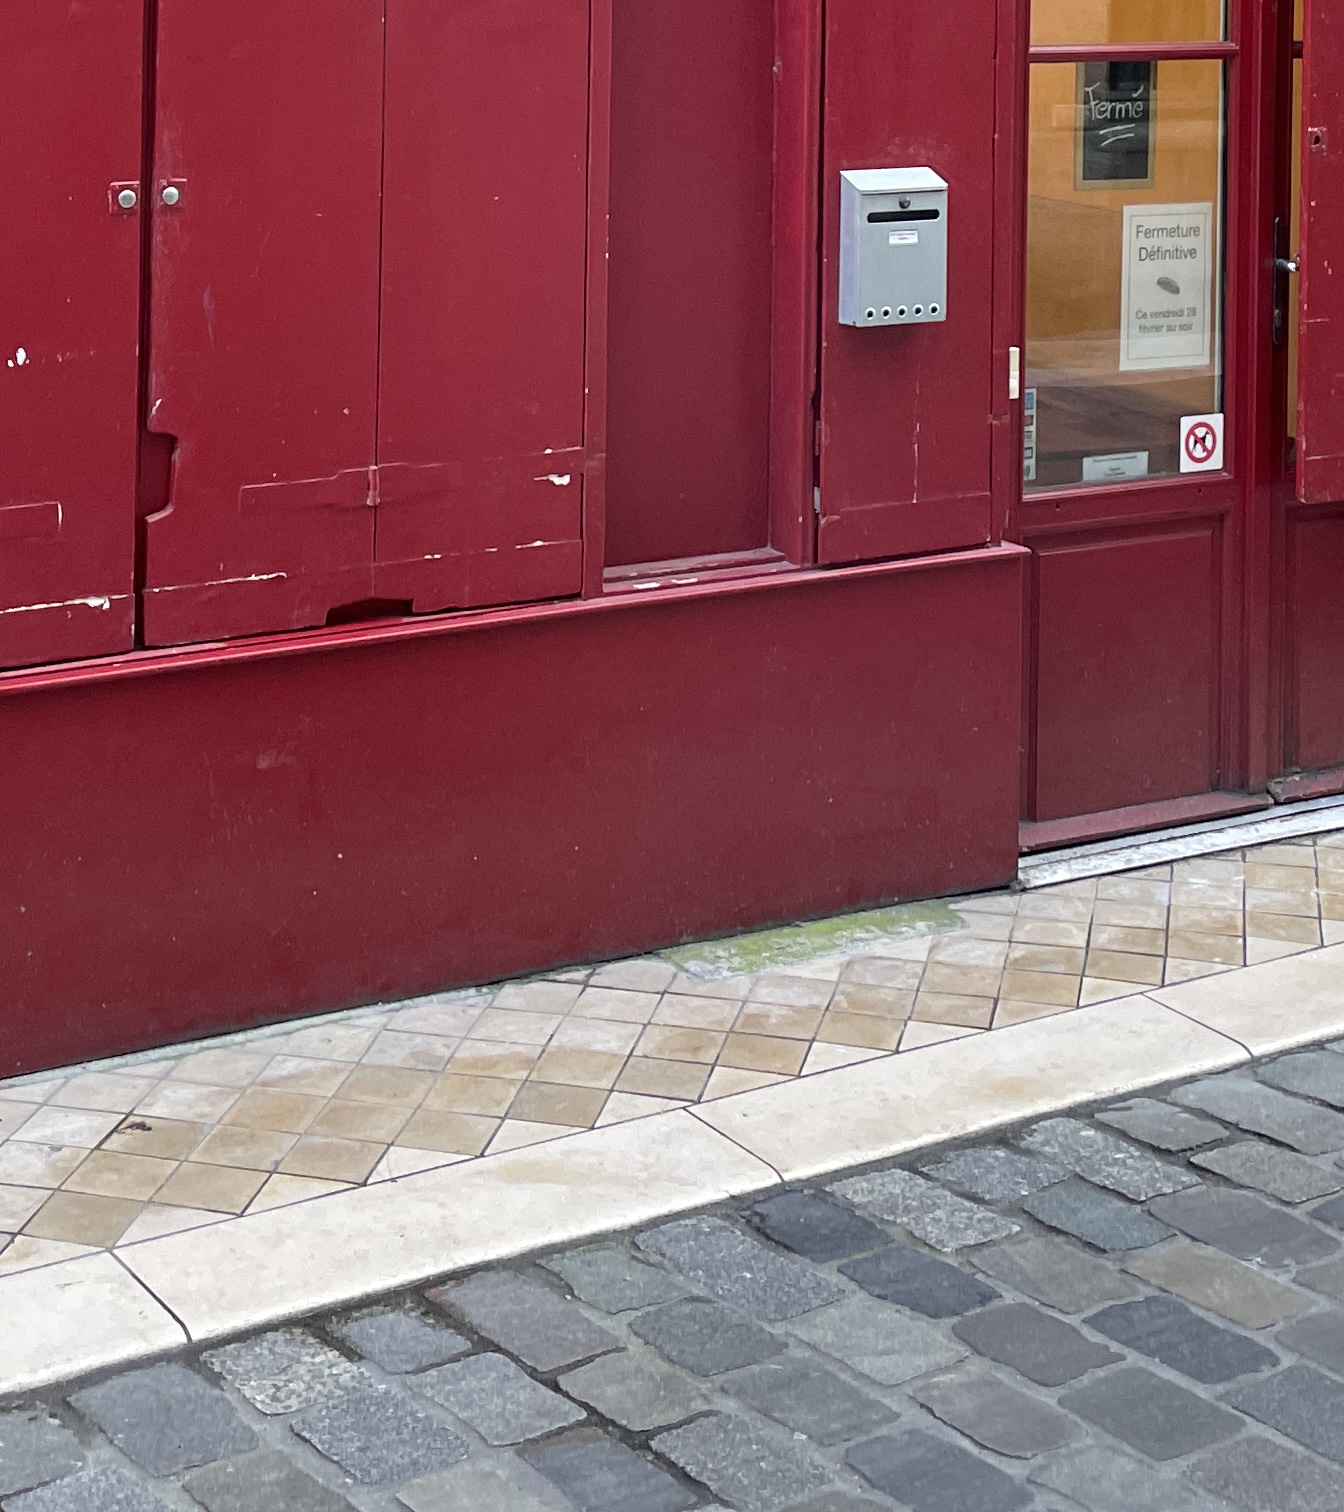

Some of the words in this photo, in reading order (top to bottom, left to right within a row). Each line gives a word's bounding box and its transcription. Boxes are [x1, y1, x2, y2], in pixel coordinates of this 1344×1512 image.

[1084, 82, 1144, 121] Fermé
[1136, 224, 1201, 239] Fermeture
[1138, 245, 1197, 262] Définitive
